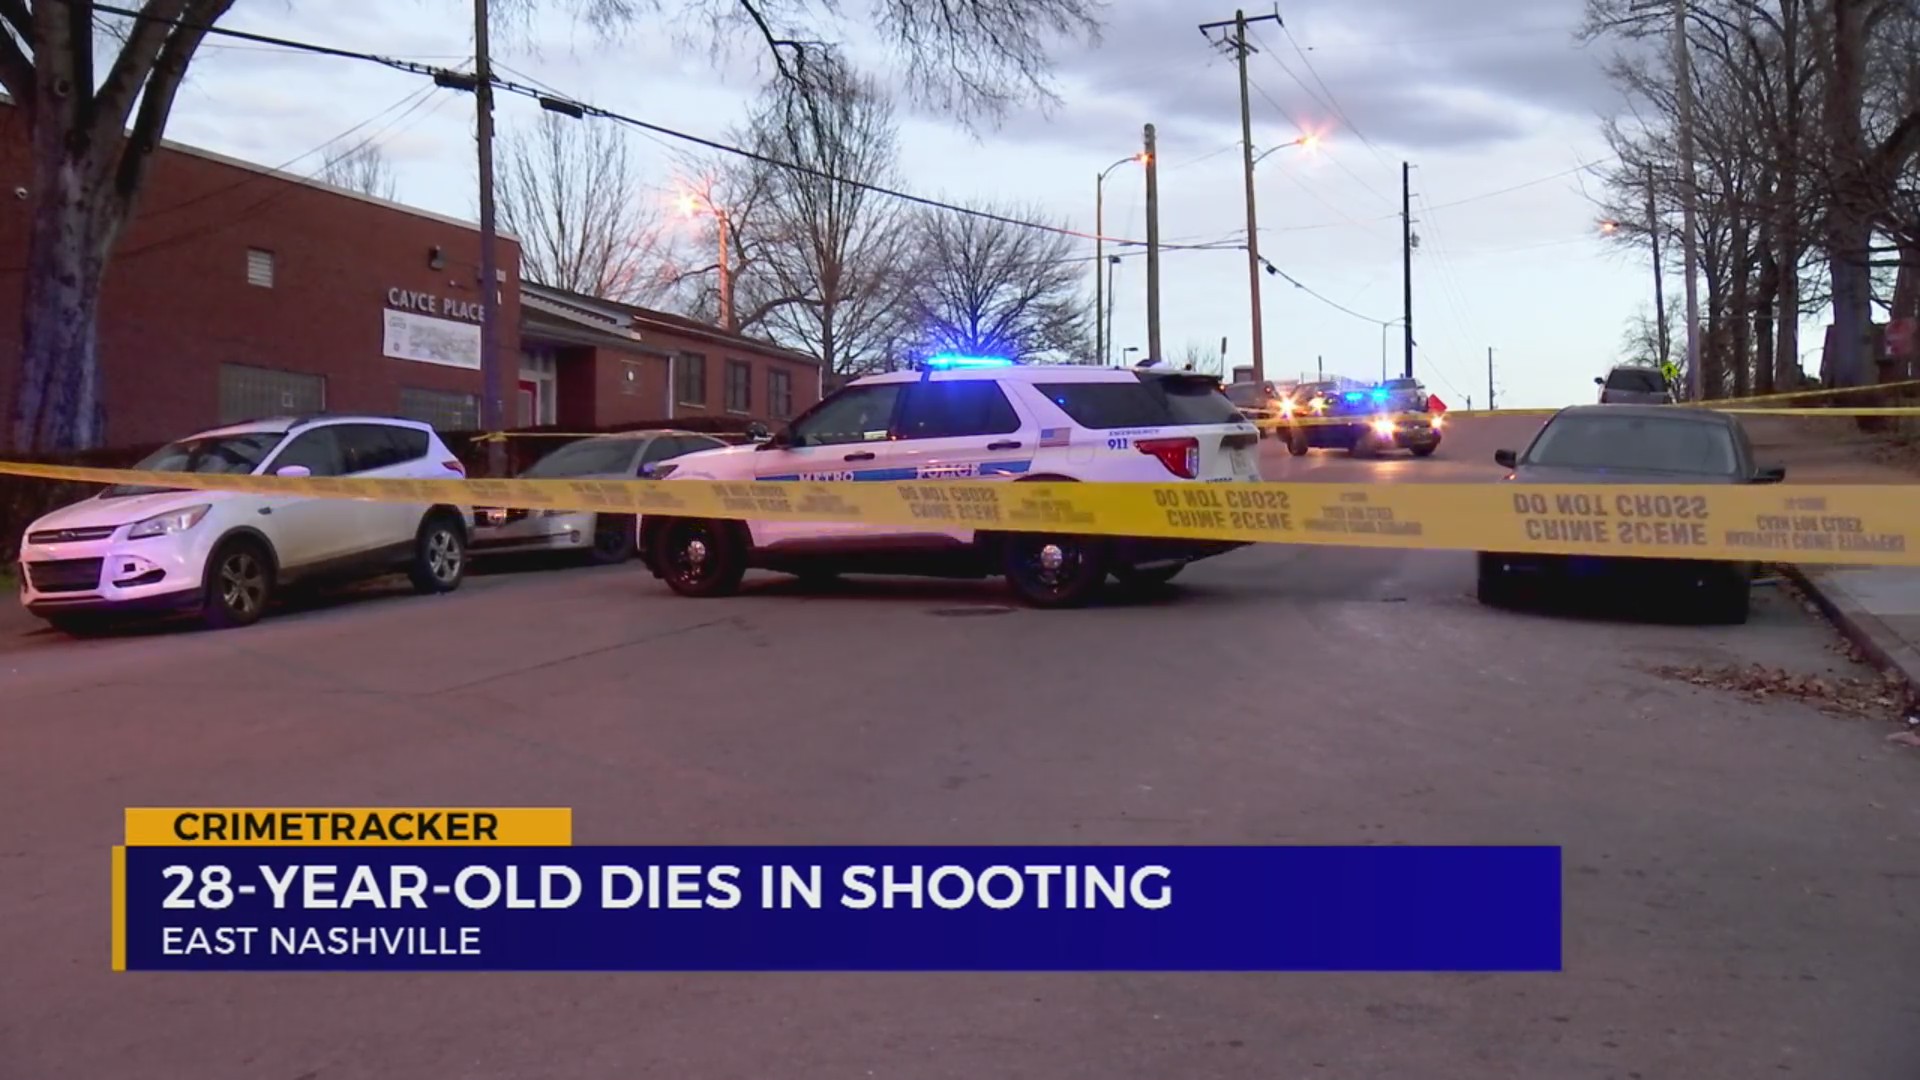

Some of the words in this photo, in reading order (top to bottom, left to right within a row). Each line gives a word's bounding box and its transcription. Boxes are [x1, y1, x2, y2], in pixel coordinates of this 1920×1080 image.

[387, 287, 436, 313] CAYCE
[443, 298, 485, 322] PLACE
[1107, 437, 1128, 450] 911
